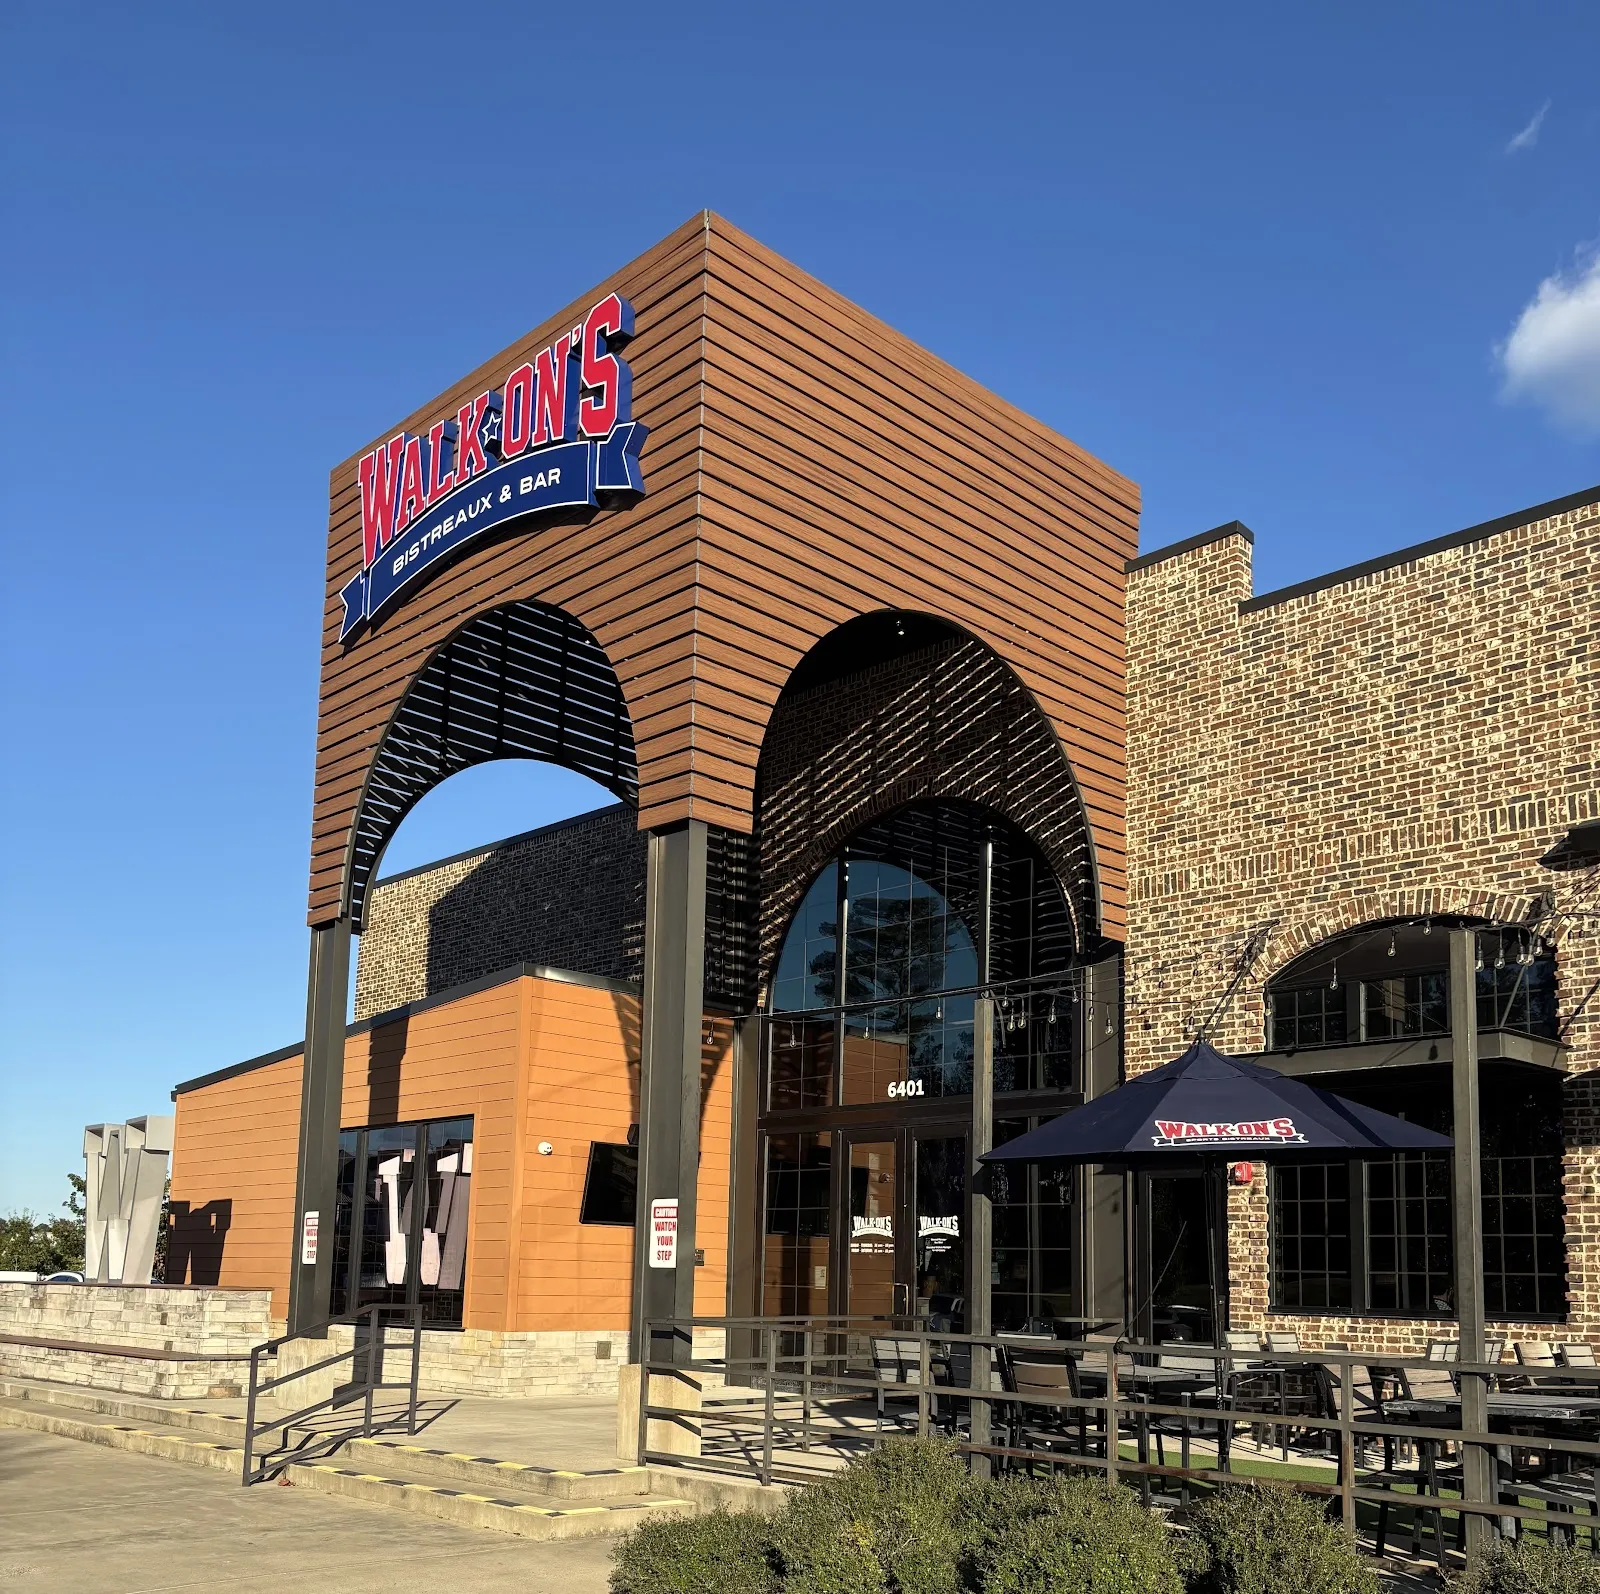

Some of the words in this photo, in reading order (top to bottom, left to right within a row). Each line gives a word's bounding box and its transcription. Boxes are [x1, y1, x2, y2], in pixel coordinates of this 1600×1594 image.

[393, 492, 493, 576] BISTREAUX
[499, 484, 512, 503] &
[519, 467, 561, 495] BAR
[887, 1079, 925, 1098] 6401
[655, 1221, 677, 1231] WATCH
[656, 1236, 673, 1246] YOUR
[656, 1250, 672, 1260] STEP
